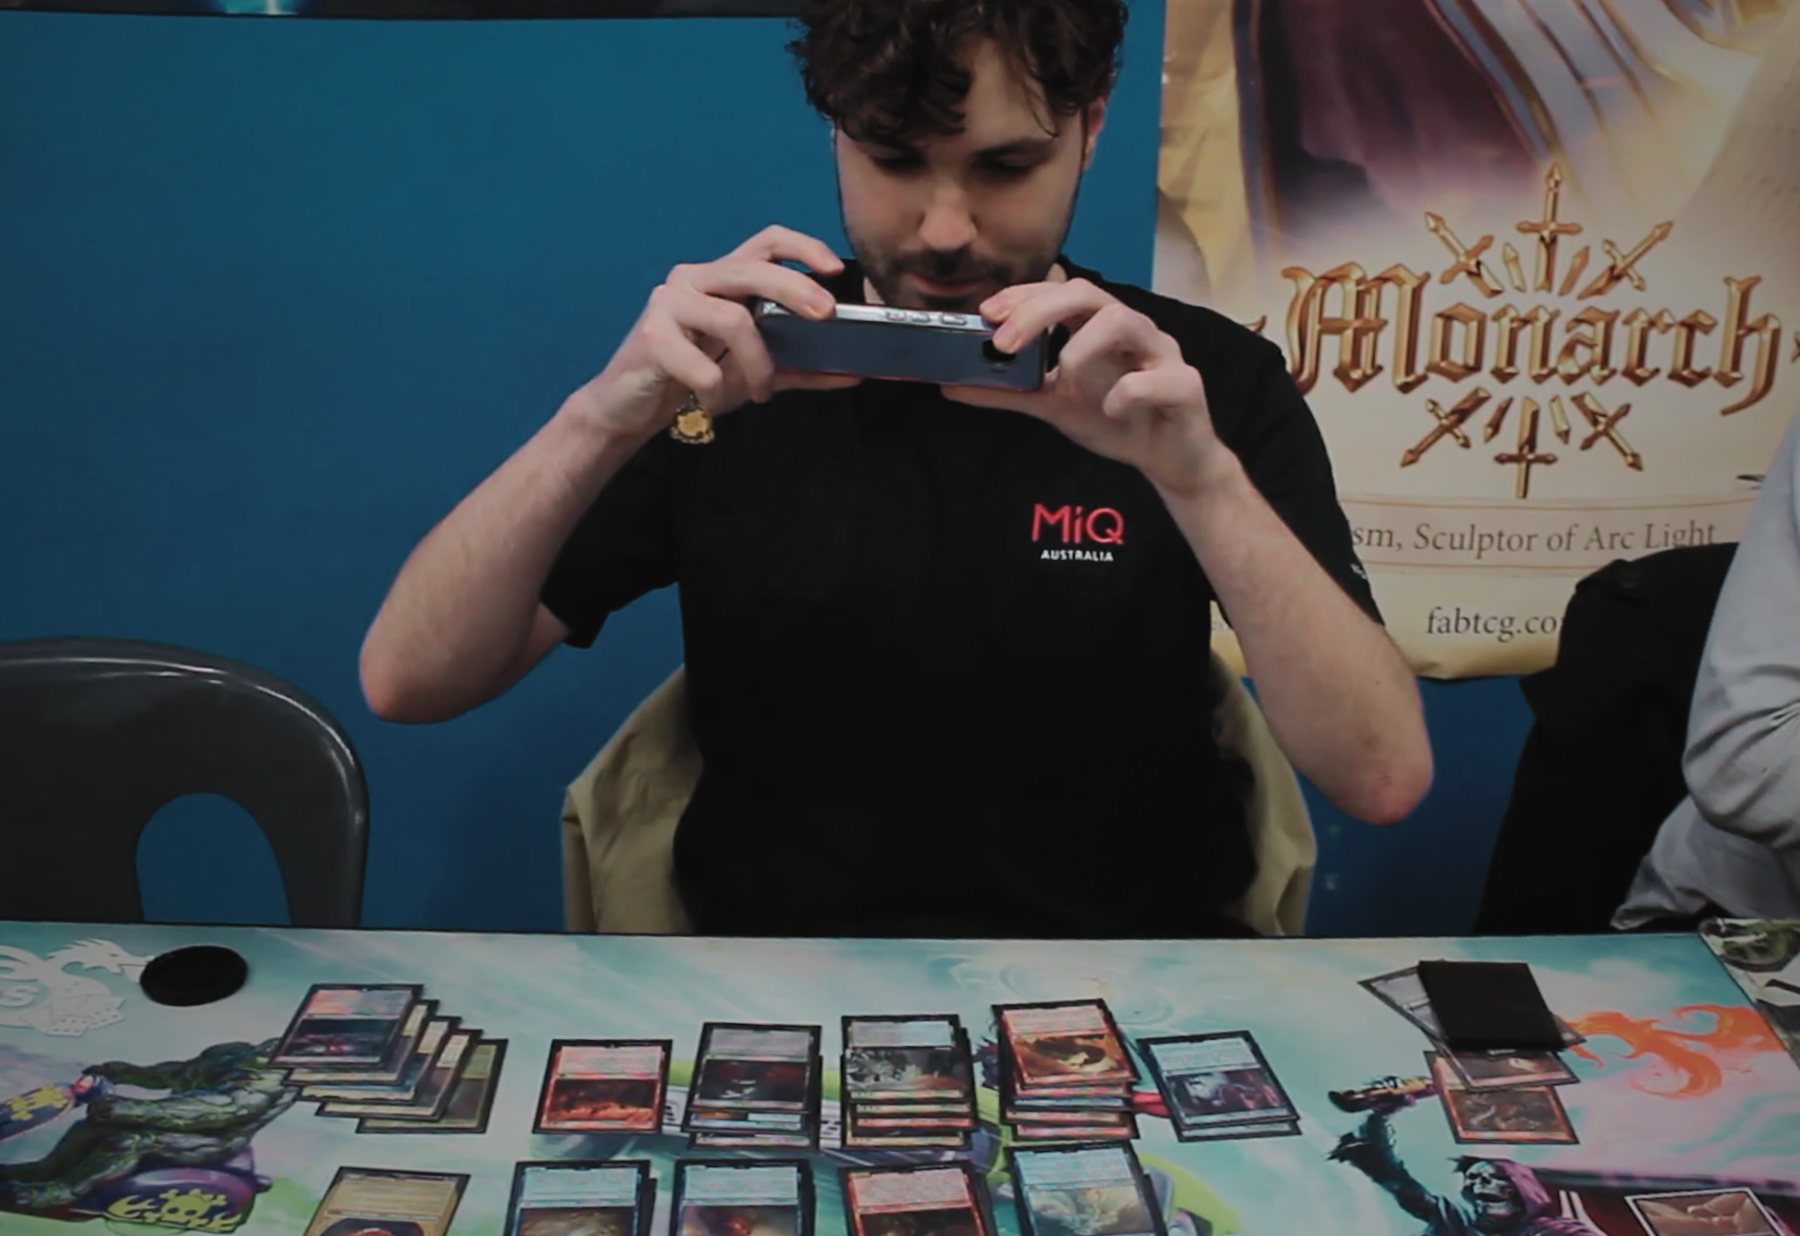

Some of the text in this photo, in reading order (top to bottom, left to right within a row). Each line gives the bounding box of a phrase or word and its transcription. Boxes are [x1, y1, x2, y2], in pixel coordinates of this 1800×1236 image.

[1279, 263, 1781, 416] Monarch
[1031, 502, 1126, 546] MiQ
[1352, 521, 1715, 560] sm, Sculptor of Arc Light
[1040, 549, 1114, 562] AUSTRALIA
[1426, 606, 1565, 643] fabtcg.co
